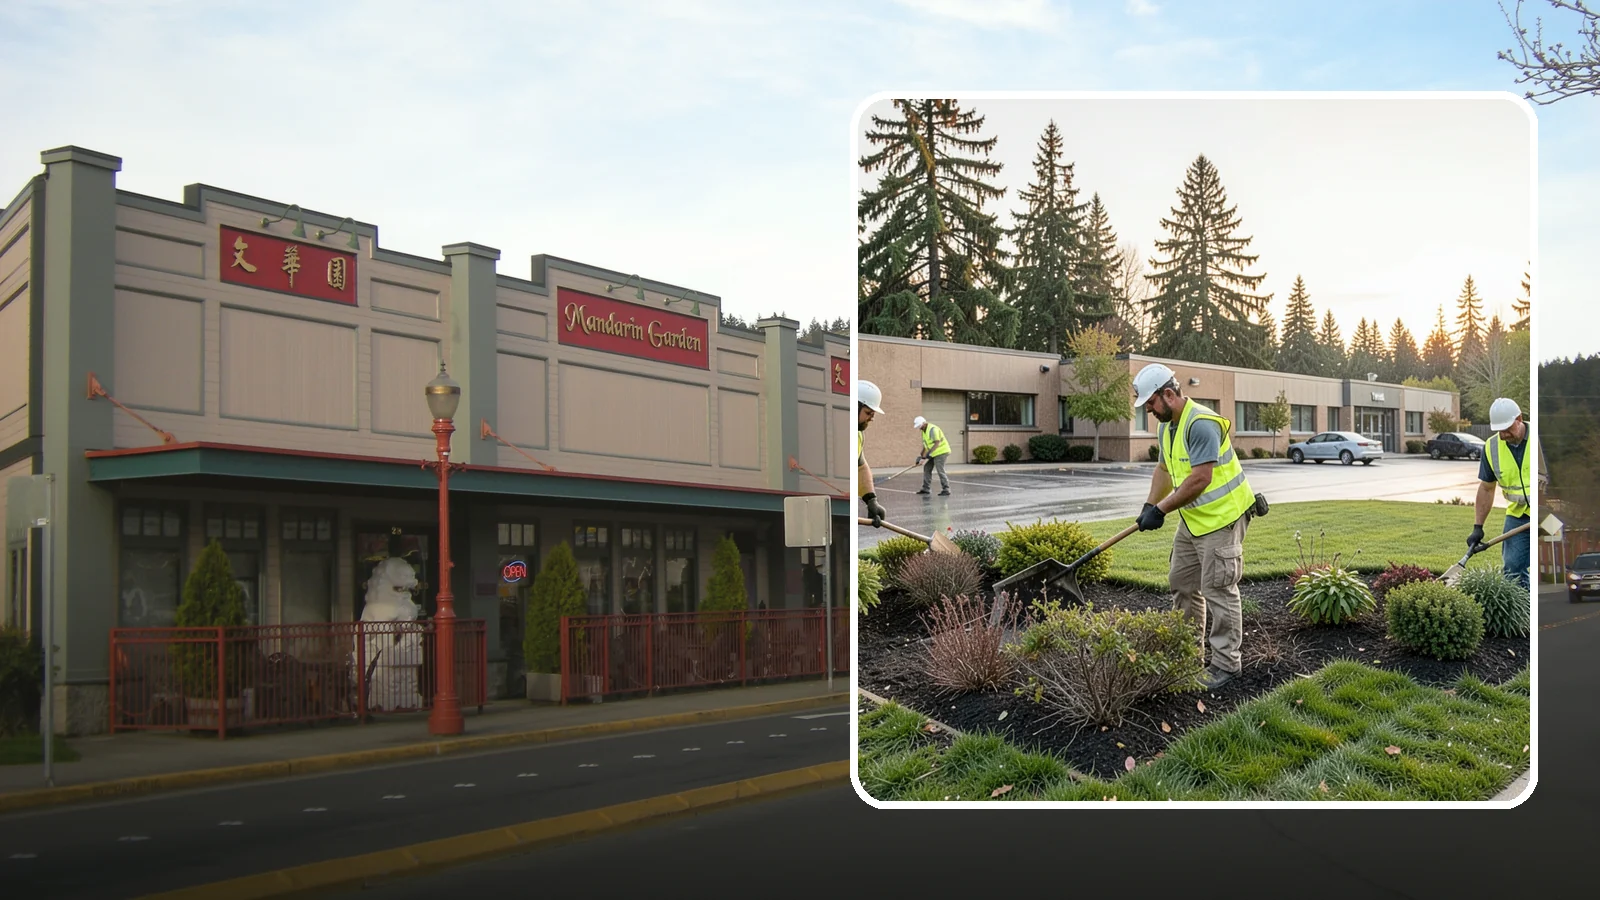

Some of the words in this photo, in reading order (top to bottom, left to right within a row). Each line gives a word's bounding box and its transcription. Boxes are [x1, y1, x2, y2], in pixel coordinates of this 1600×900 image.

[230, 235, 346, 291] 文華園
[564, 302, 644, 341] Mandarin
[648, 320, 702, 352] Garden
[503, 565, 527, 578] OPEN
